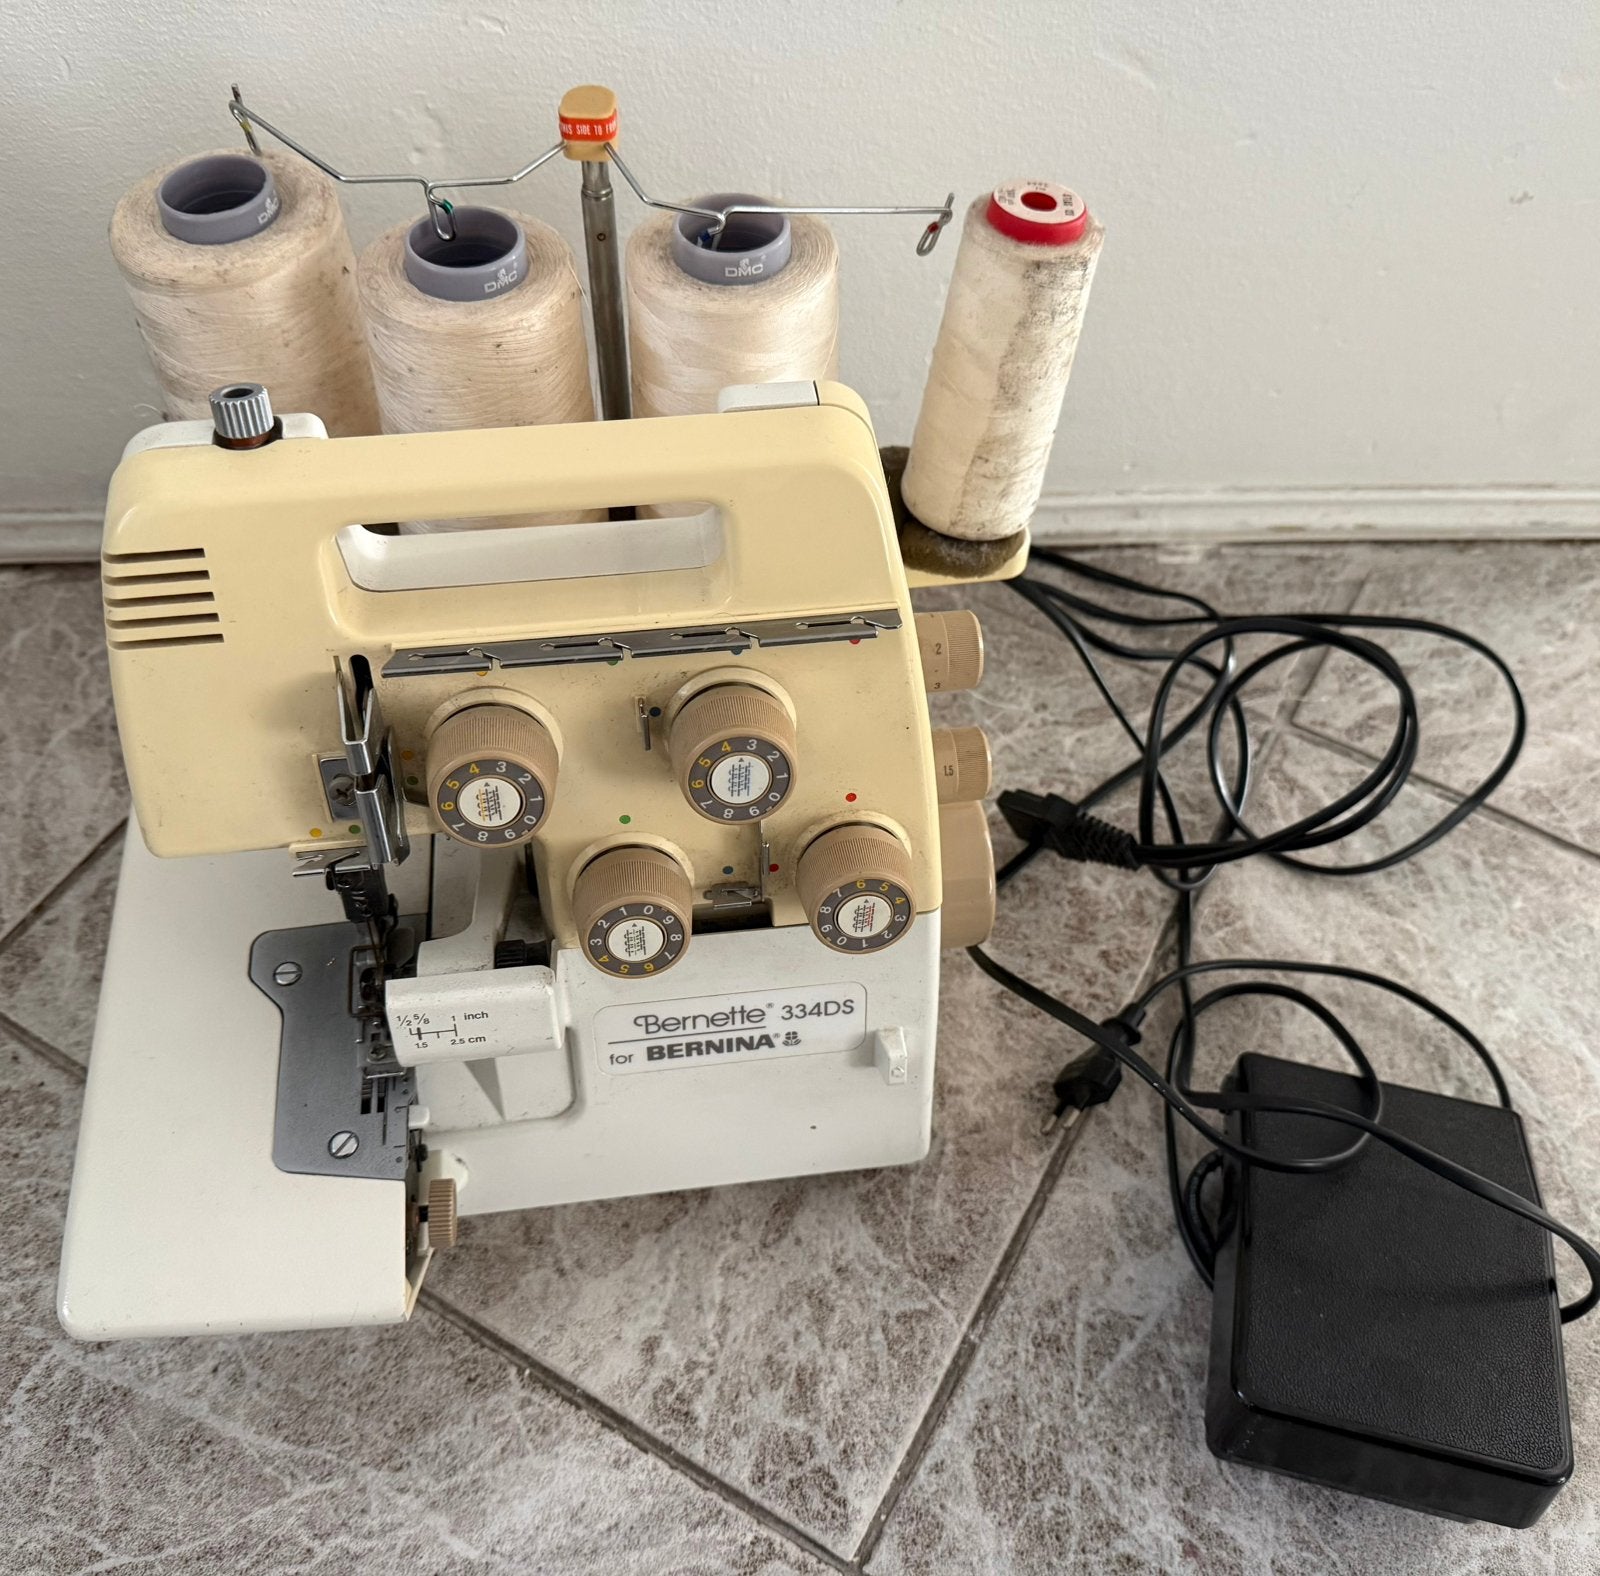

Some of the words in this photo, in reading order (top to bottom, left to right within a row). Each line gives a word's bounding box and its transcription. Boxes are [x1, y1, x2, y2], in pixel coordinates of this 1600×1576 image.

[576, 124, 591, 135] SIDE
[594, 125, 602, 135] TO
[725, 264, 763, 277] DMC
[484, 270, 517, 293] DMC
[935, 643, 941, 655] 2
[722, 741, 731, 752] 4
[747, 739, 757, 750] 3
[767, 751, 780, 762] 2
[698, 757, 711, 767] 5
[469, 763, 480, 774] 4
[496, 762, 507, 772] 3
[518, 773, 531, 784] 2
[446, 780, 459, 789] 5
[769, 793, 780, 801] 0
[700, 800, 713, 808] 7
[723, 808, 734, 818] 8
[524, 815, 536, 824] 0
[452, 823, 465, 831] 7
[477, 831, 488, 841] 8
[879, 882, 890, 891] 5
[833, 888, 842, 897] 7
[619, 907, 627, 915] 1
[644, 905, 653, 914] 0
[598, 920, 610, 928] 2
[881, 930, 892, 939] 2
[590, 938, 602, 946] 3
[837, 936, 847, 945] 0
[862, 939, 868, 947] 1
[664, 951, 674, 960] 7
[620, 964, 630, 973] 5
[780, 999, 855, 1021] 334DS
[464, 1011, 488, 1020] inch
[609, 1053, 634, 1065] for
